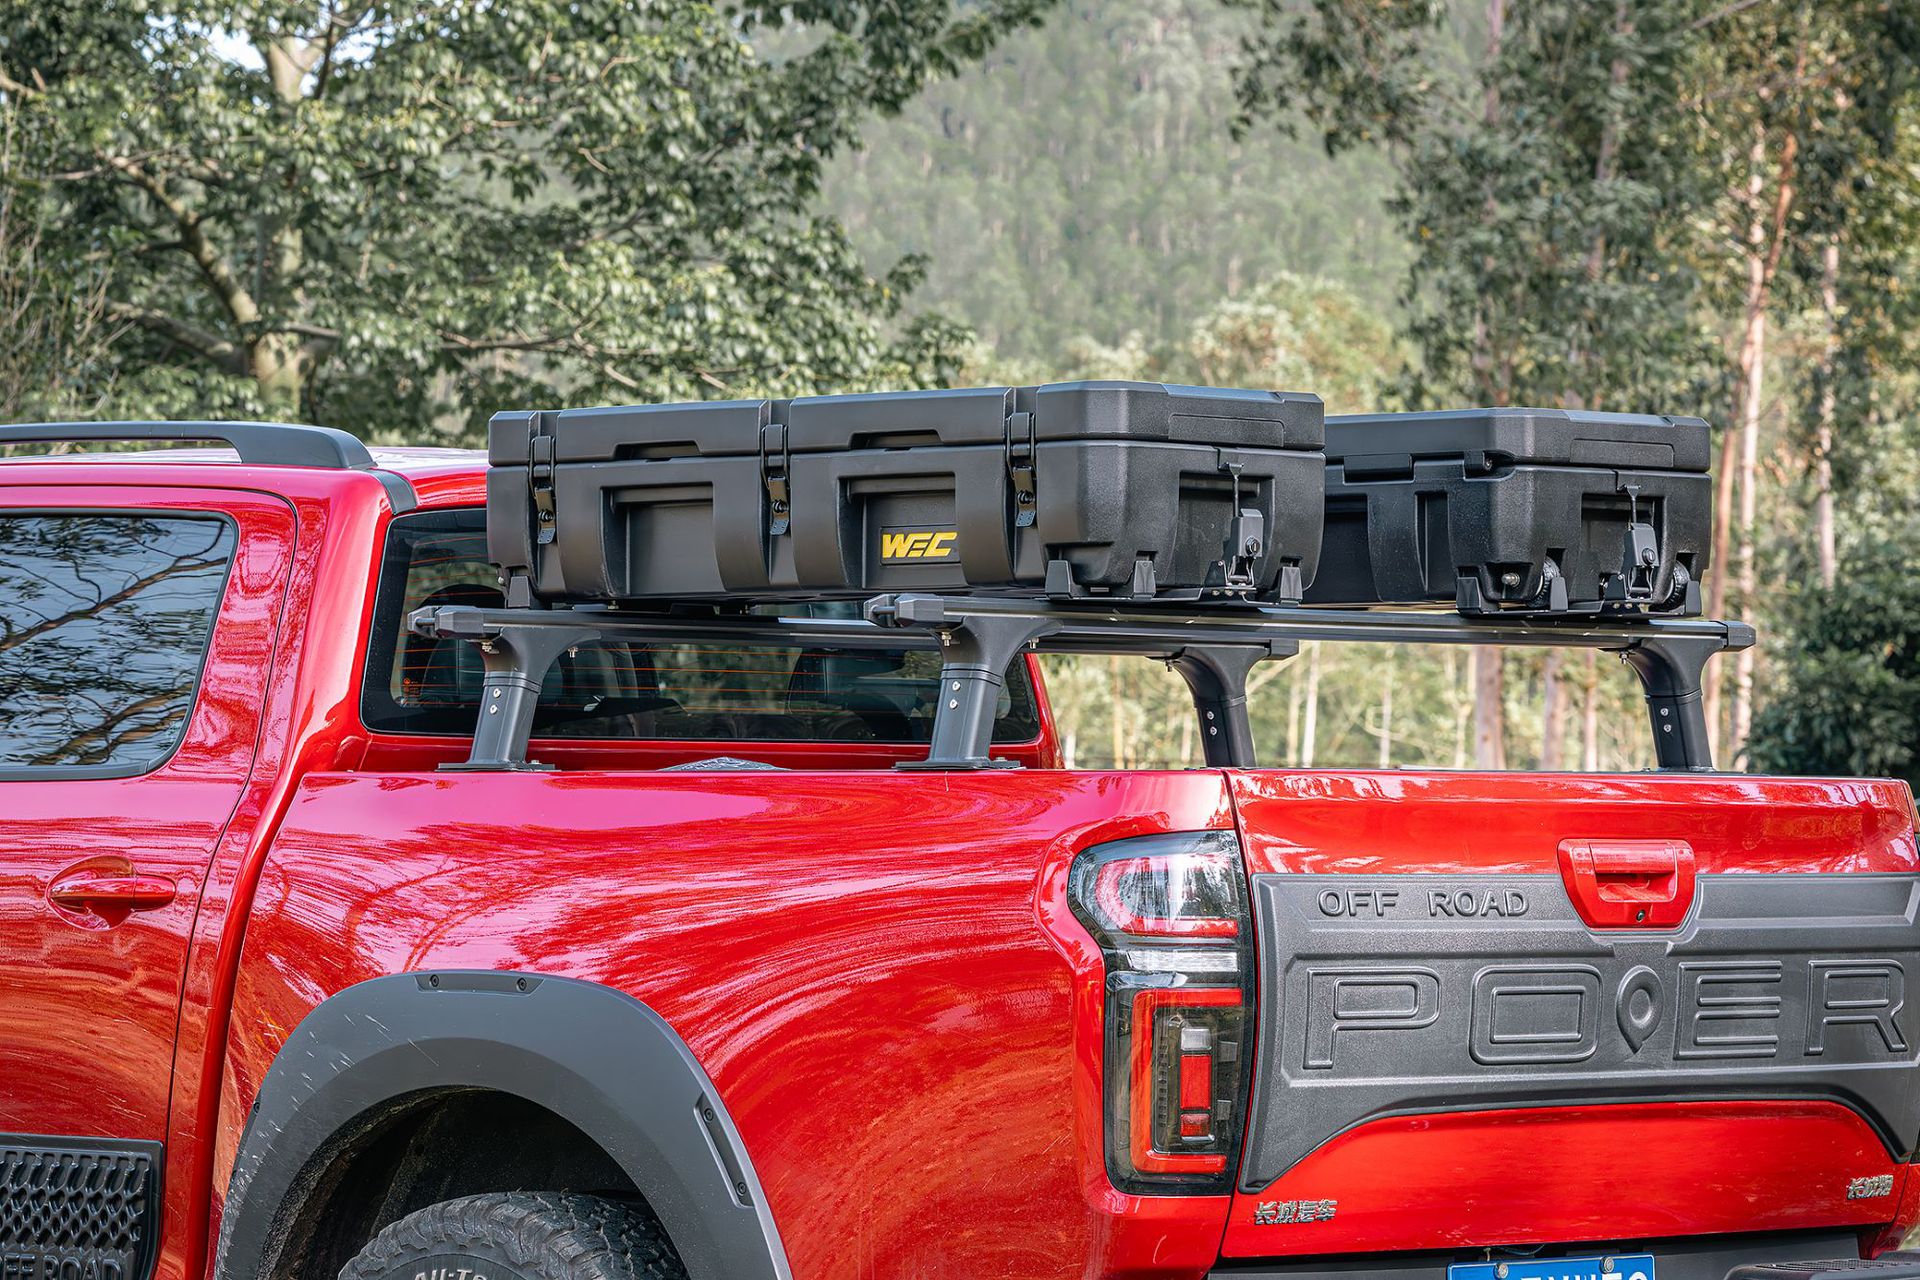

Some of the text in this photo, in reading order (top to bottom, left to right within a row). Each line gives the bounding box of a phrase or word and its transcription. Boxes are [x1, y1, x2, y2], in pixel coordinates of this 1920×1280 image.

[1317, 887, 1530, 917] OFF ROAD
[1254, 1199, 1338, 1225] 长城汽车
[0, 1252, 36, 1280] FF
